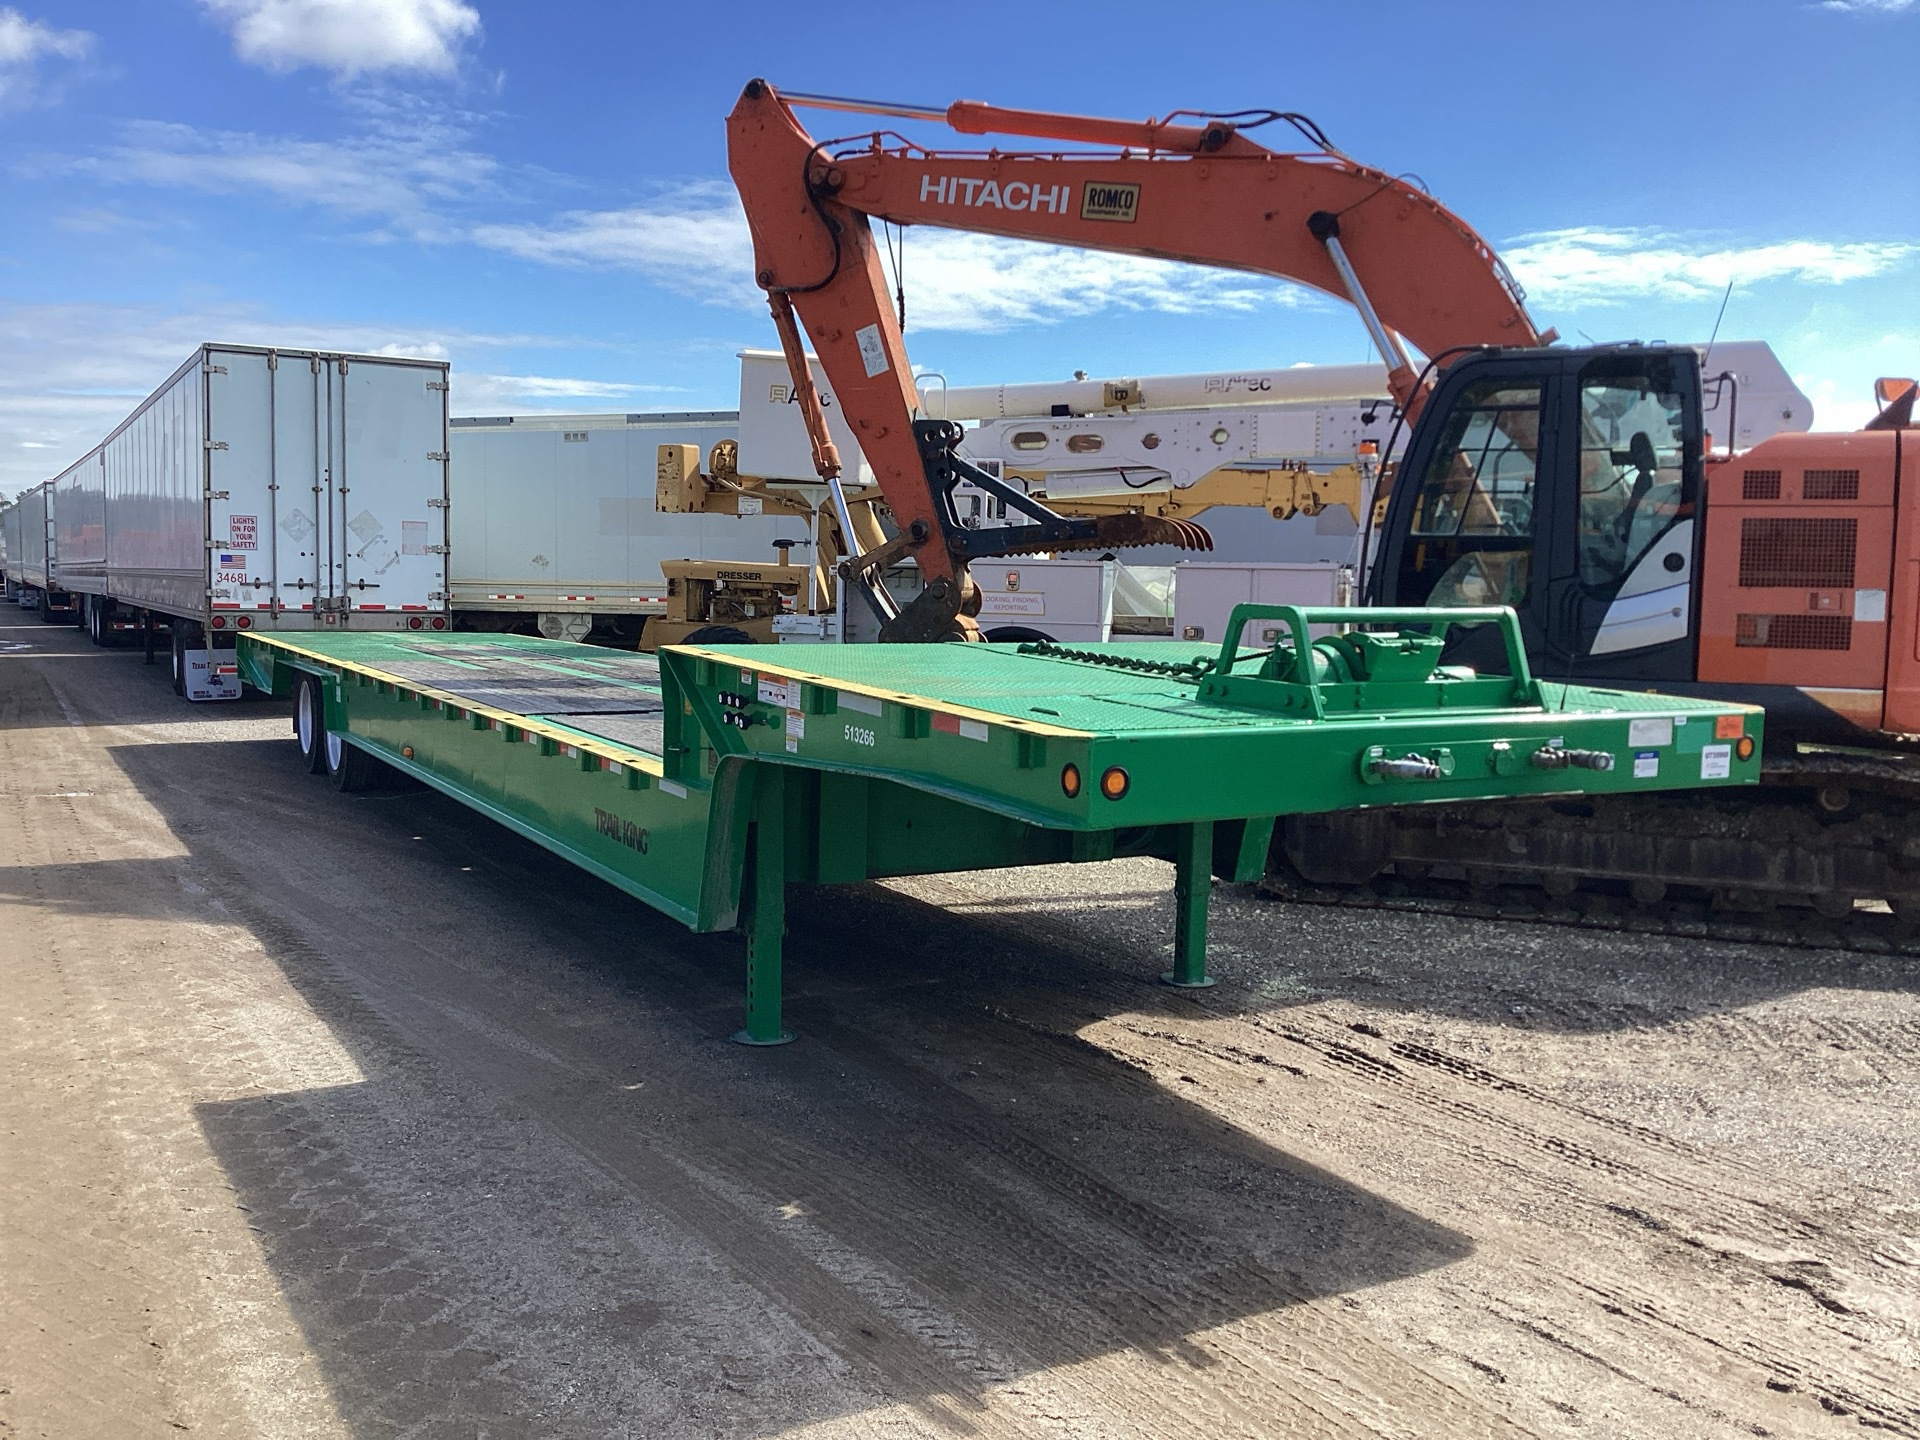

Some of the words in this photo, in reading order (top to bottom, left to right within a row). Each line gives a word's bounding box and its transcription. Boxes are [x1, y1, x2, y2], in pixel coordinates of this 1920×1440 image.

[919, 174, 1071, 214] HITACHI
[1087, 187, 1134, 209] ROMCO
[232, 517, 255, 525] LIGHTS
[243, 525, 256, 533] FOR
[232, 541, 256, 549] SAFETY
[216, 572, 247, 584] 34681
[717, 570, 762, 581] DRESSER
[1013, 596, 1040, 605] FINDING,
[844, 724, 875, 747] 513266
